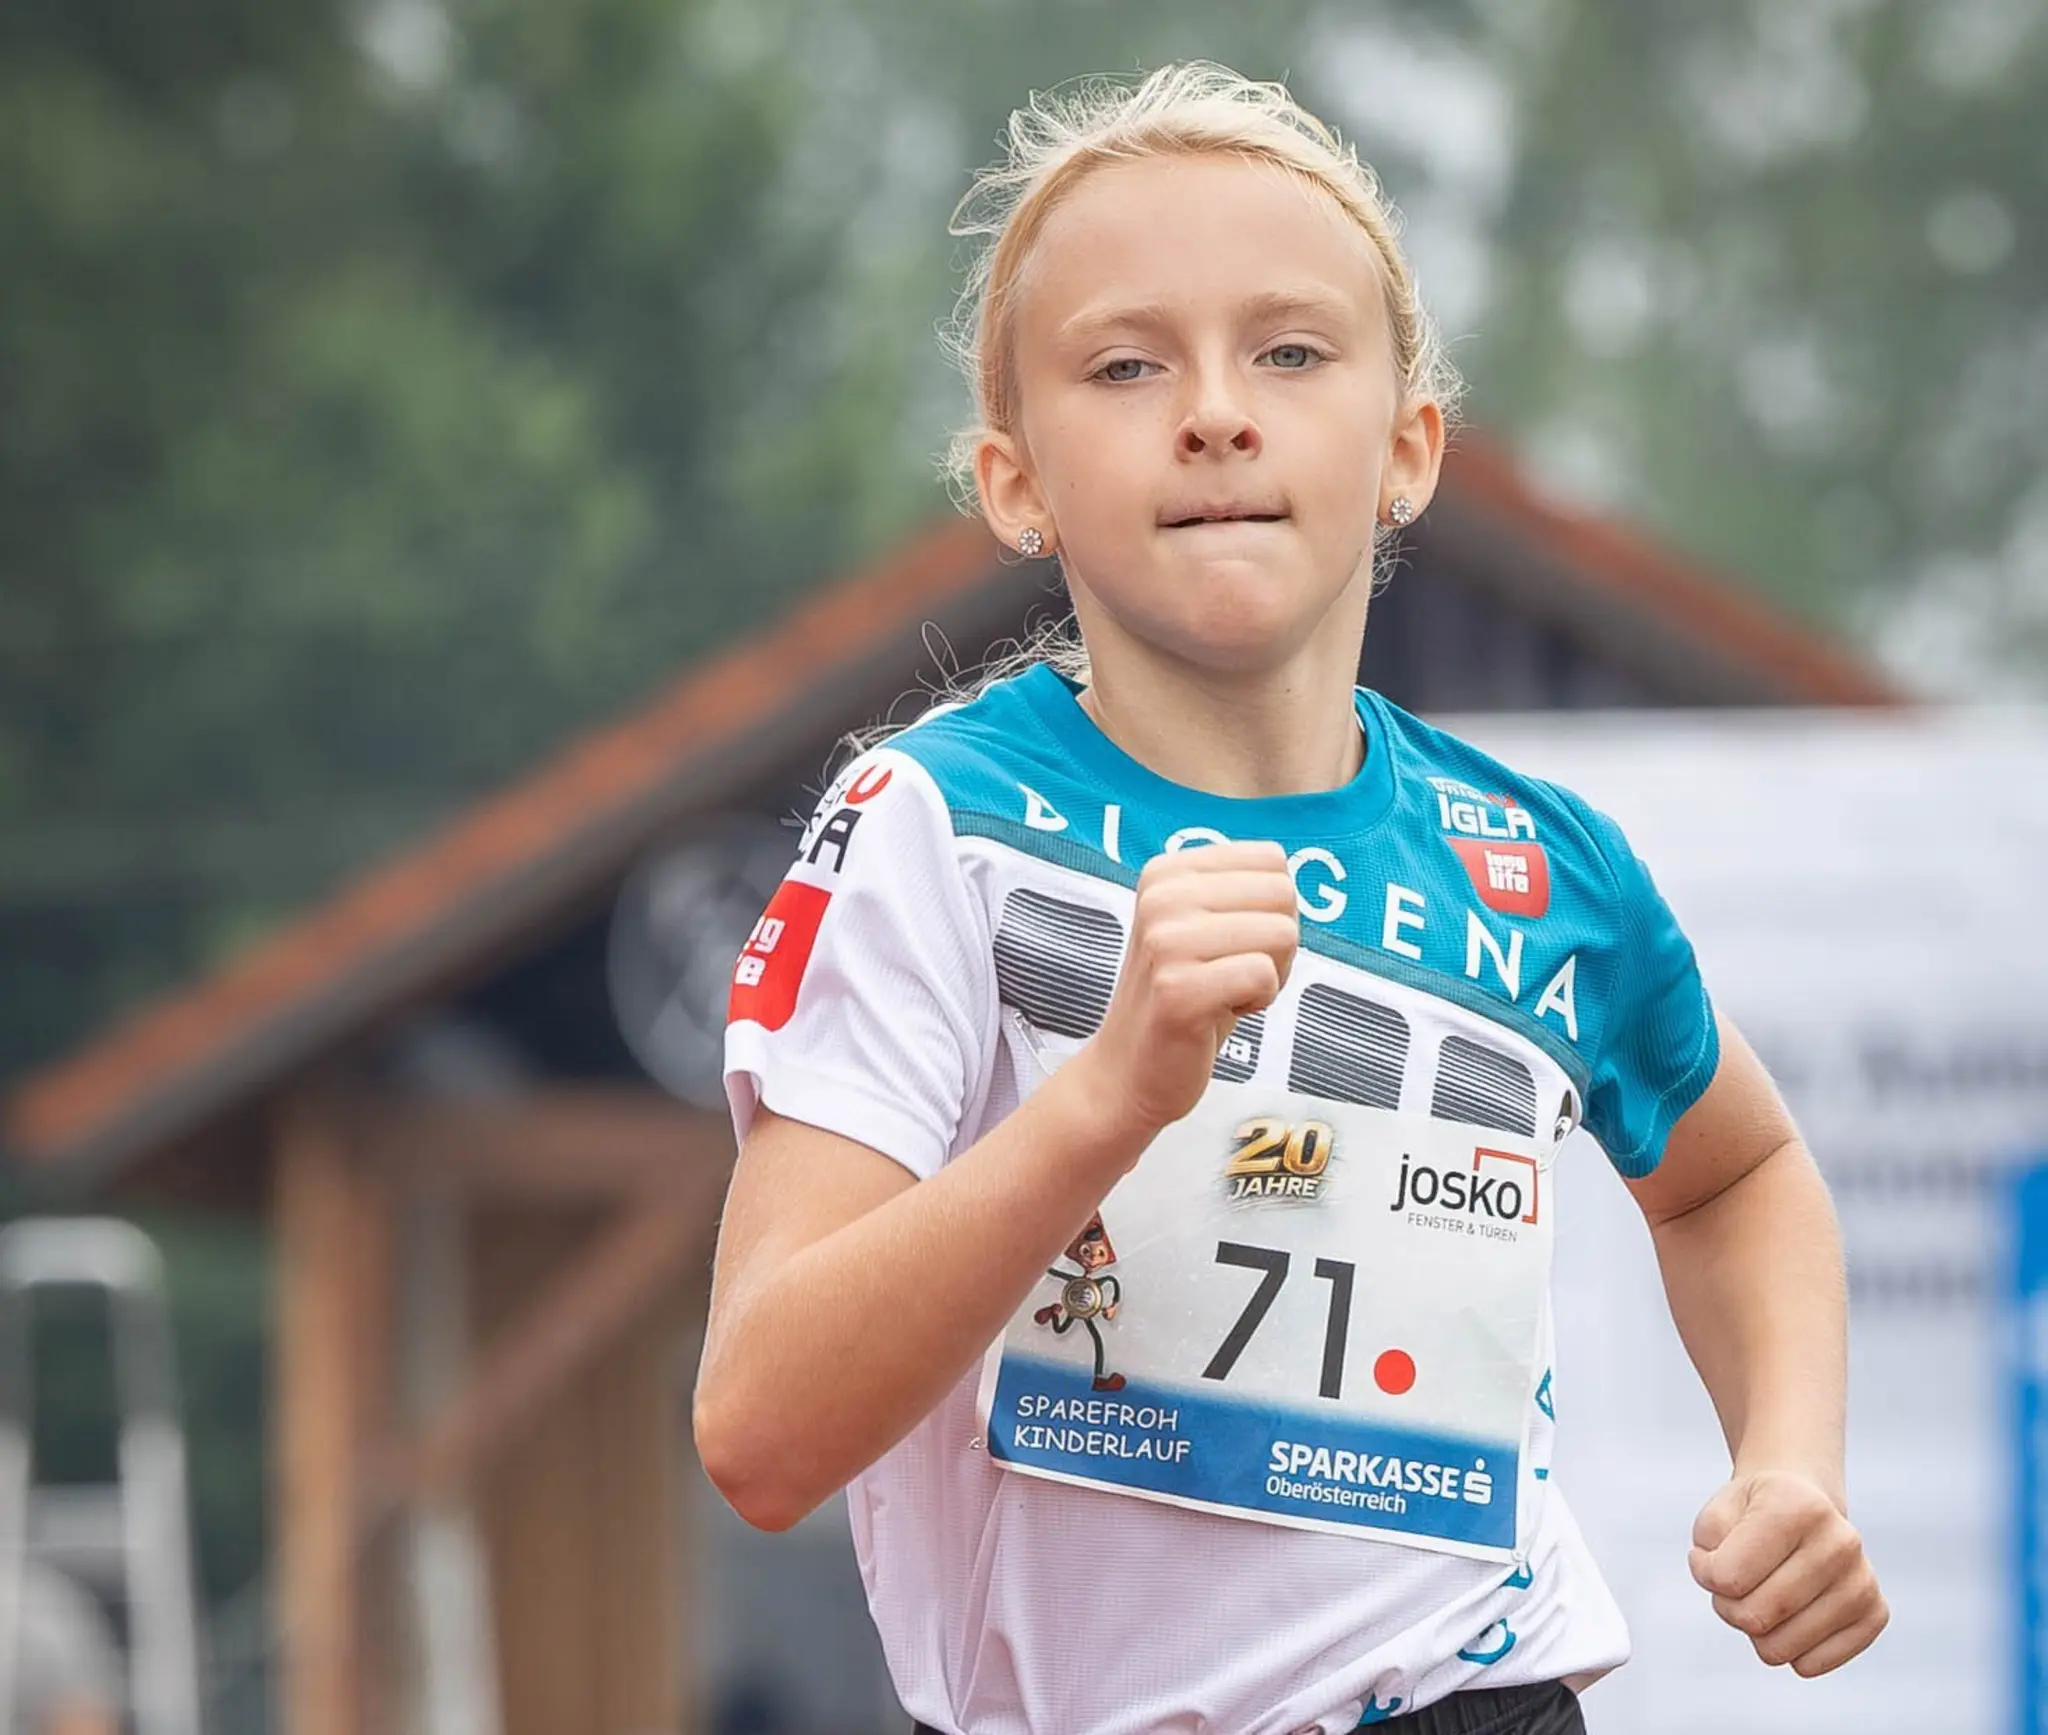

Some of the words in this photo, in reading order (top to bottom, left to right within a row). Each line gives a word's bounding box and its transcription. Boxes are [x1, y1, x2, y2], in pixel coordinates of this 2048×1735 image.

[1437, 792, 1537, 840] IGLA
[1226, 1116, 1334, 1177] 20
[1228, 1176, 1320, 1201] JAHRE
[1408, 1212, 1464, 1233] FENSTER
[1466, 1223, 1476, 1235] &
[1479, 1222, 1518, 1242] TÜREN
[1202, 1241, 1356, 1399] 71
[1016, 1395, 1179, 1432] SPAREFROH
[1013, 1424, 1191, 1463] KINDERLAUF
[1268, 1440, 1460, 1500] SPARKASSE
[1265, 1475, 1407, 1515] Oberösterreich
